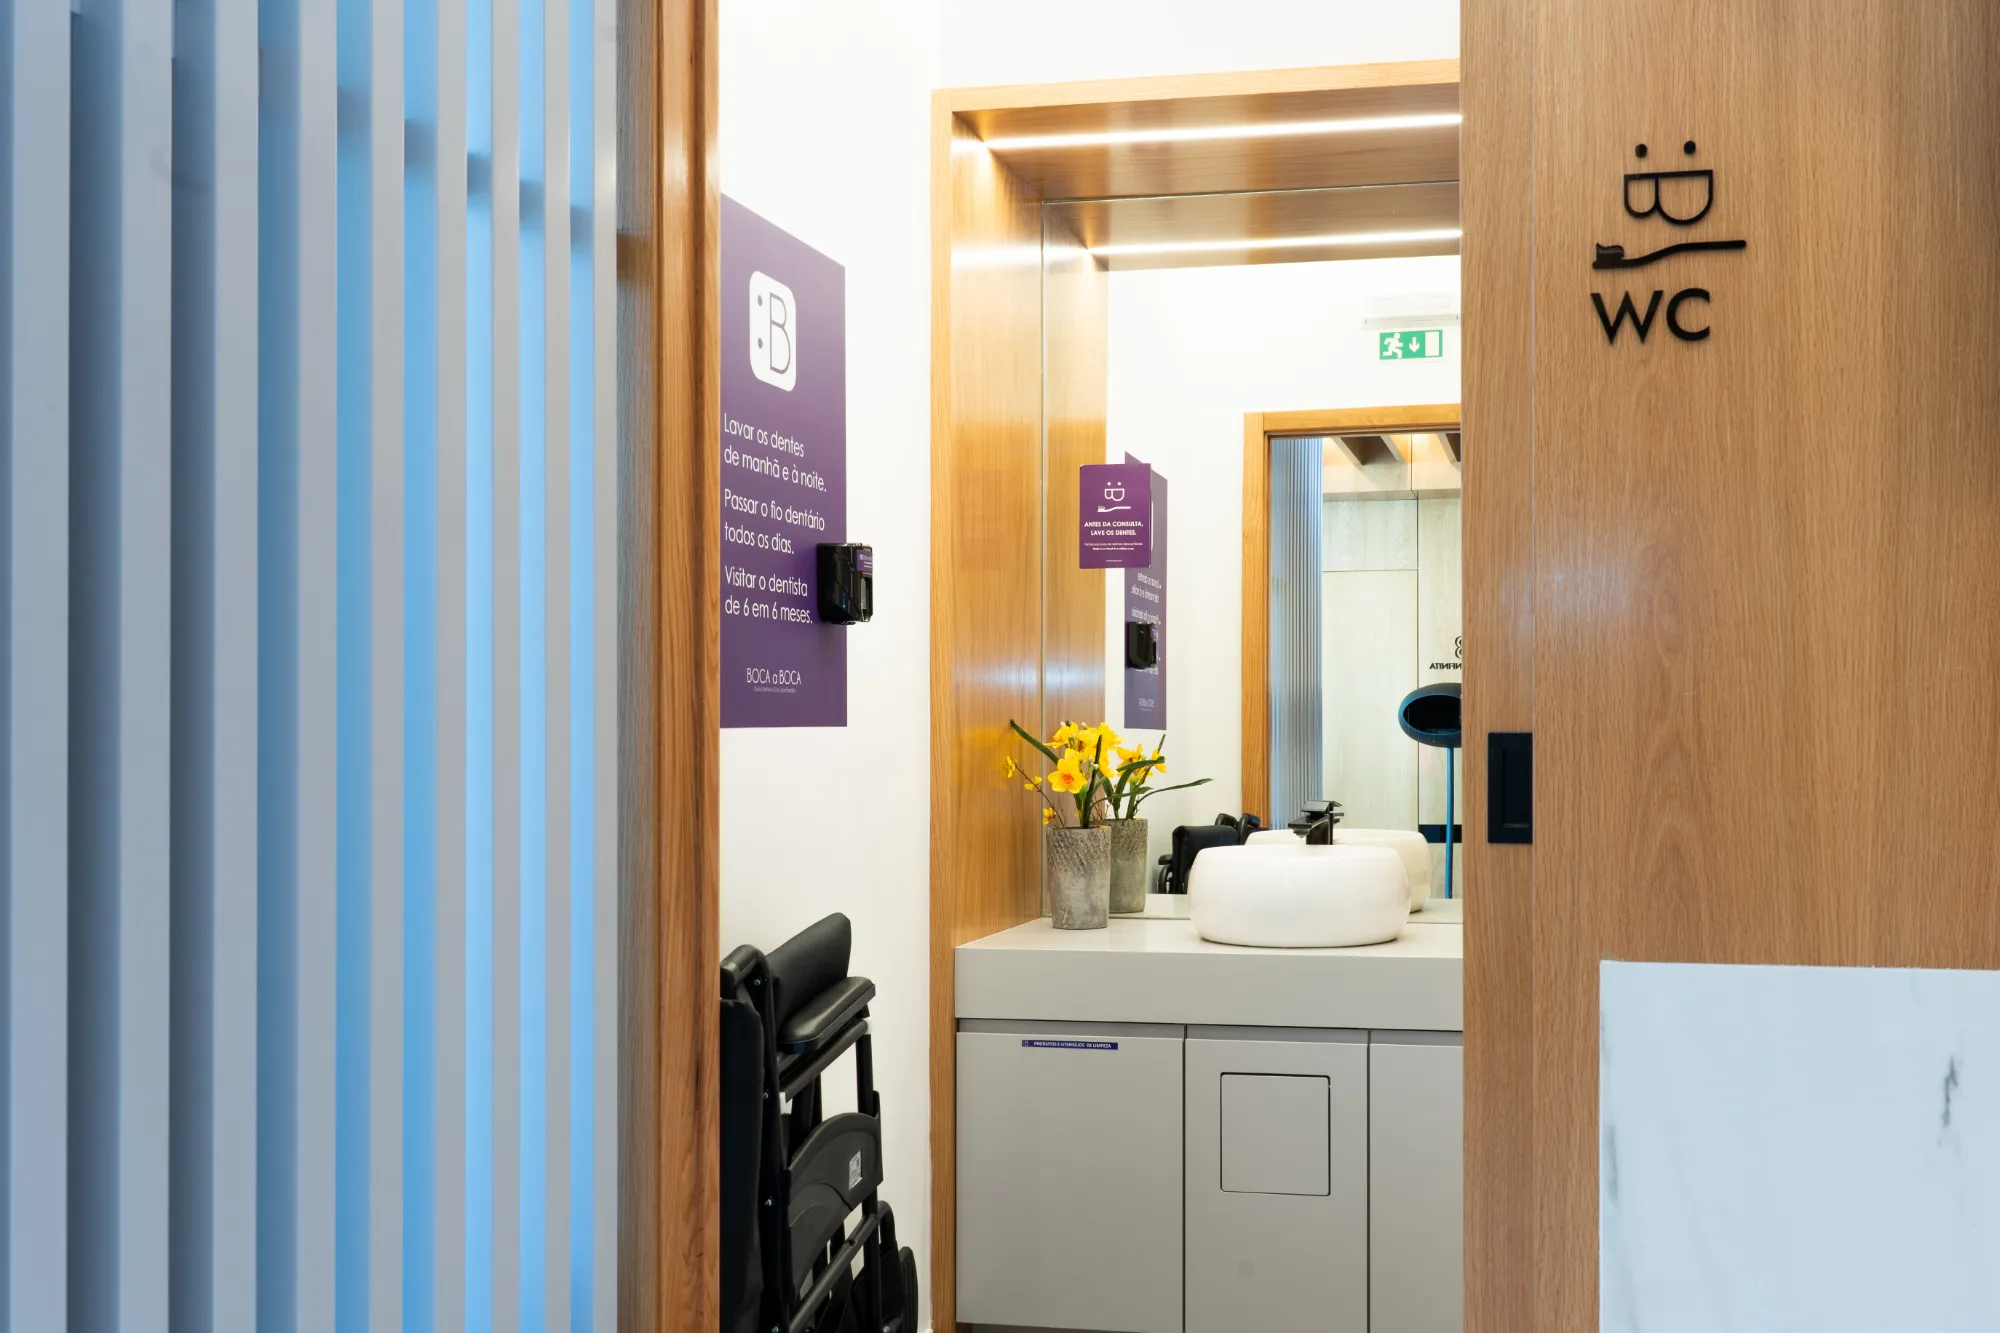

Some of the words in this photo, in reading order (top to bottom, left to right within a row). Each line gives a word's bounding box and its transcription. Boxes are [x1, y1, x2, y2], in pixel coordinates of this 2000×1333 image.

[1590, 287, 1710, 345] WC
[724, 413, 754, 440] Lavar
[757, 429, 768, 445] os
[771, 431, 804, 457] dentes
[724, 445, 739, 466] de
[742, 453, 779, 478] manhã
[782, 466, 789, 480] e
[792, 464, 798, 483] à
[801, 471, 827, 492] noite.
[724, 489, 758, 514] Passar
[761, 502, 768, 517] o
[771, 500, 782, 520] fio
[785, 505, 825, 531] dentário
[725, 521, 755, 545] todos
[758, 533, 768, 549] os
[771, 533, 795, 554] dias.
[725, 565, 756, 588] Visitar
[759, 576, 766, 590] o
[769, 574, 807, 597] dentista
[725, 595, 740, 615] de
[743, 597, 749, 616] 6
[752, 602, 769, 618] em
[772, 601, 777, 620] 6
[780, 606, 813, 624] meses.
[747, 667, 770, 683] BOCA
[772, 673, 777, 684] a
[779, 669, 801, 685] BOCA
